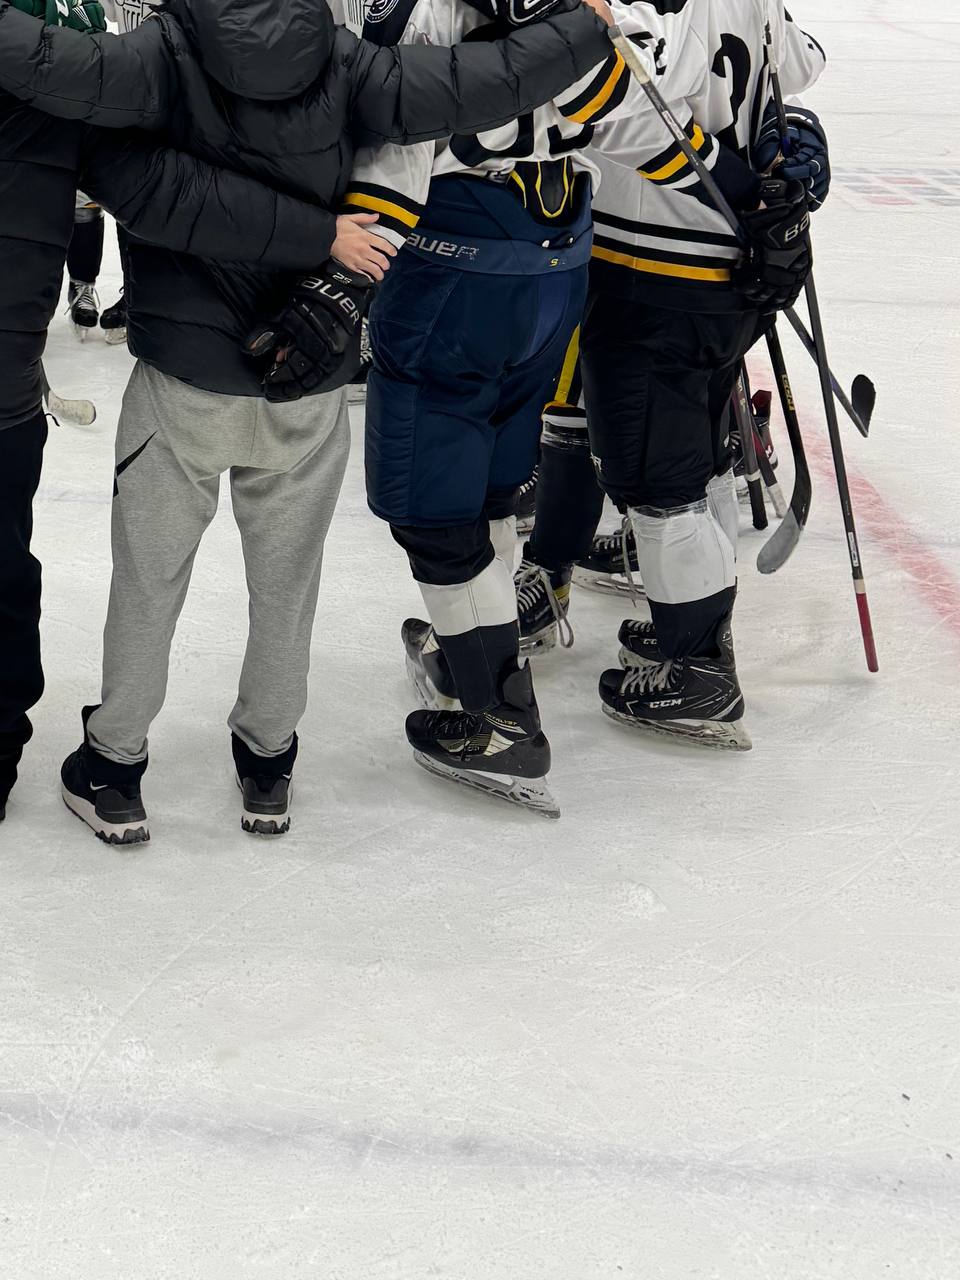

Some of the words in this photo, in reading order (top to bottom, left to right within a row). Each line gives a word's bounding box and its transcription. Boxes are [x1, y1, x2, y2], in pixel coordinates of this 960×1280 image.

[406, 231, 480, 262] AUER
[299, 276, 360, 326] AUER
[642, 638, 658, 646] CC
[648, 698, 683, 709] CCM
